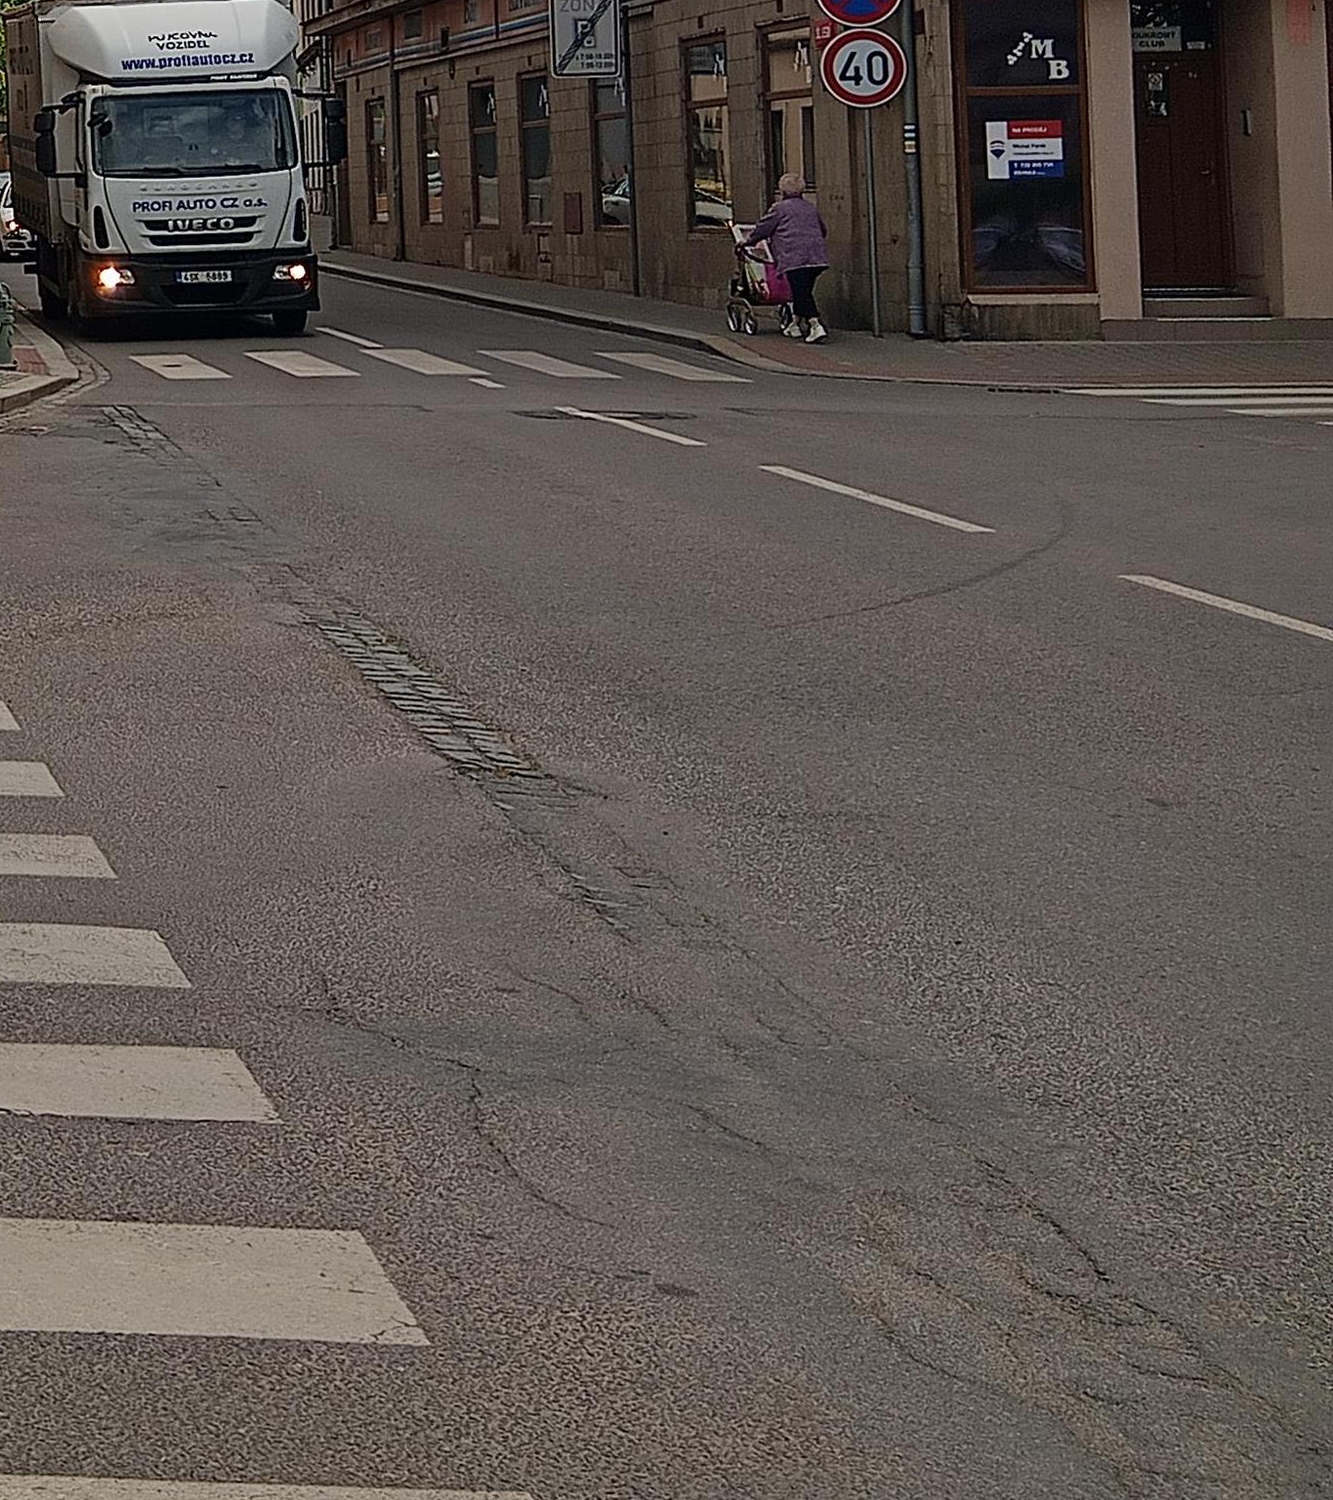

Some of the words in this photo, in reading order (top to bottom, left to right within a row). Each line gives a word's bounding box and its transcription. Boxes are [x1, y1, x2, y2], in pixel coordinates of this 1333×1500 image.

[156, 40, 210, 50] VOZIDEL
[1030, 39, 1055, 59] M
[1139, 40, 1165, 48] CLUB
[121, 53, 255, 71] www.profiautocz.cz
[838, 51, 889, 86] 40
[1048, 60, 1070, 80] B
[132, 200, 173, 213] PROFI
[176, 199, 217, 211] AUTO
[220, 197, 240, 209] CZ
[243, 198, 268, 208] a.s.
[167, 217, 235, 232] IVECO
